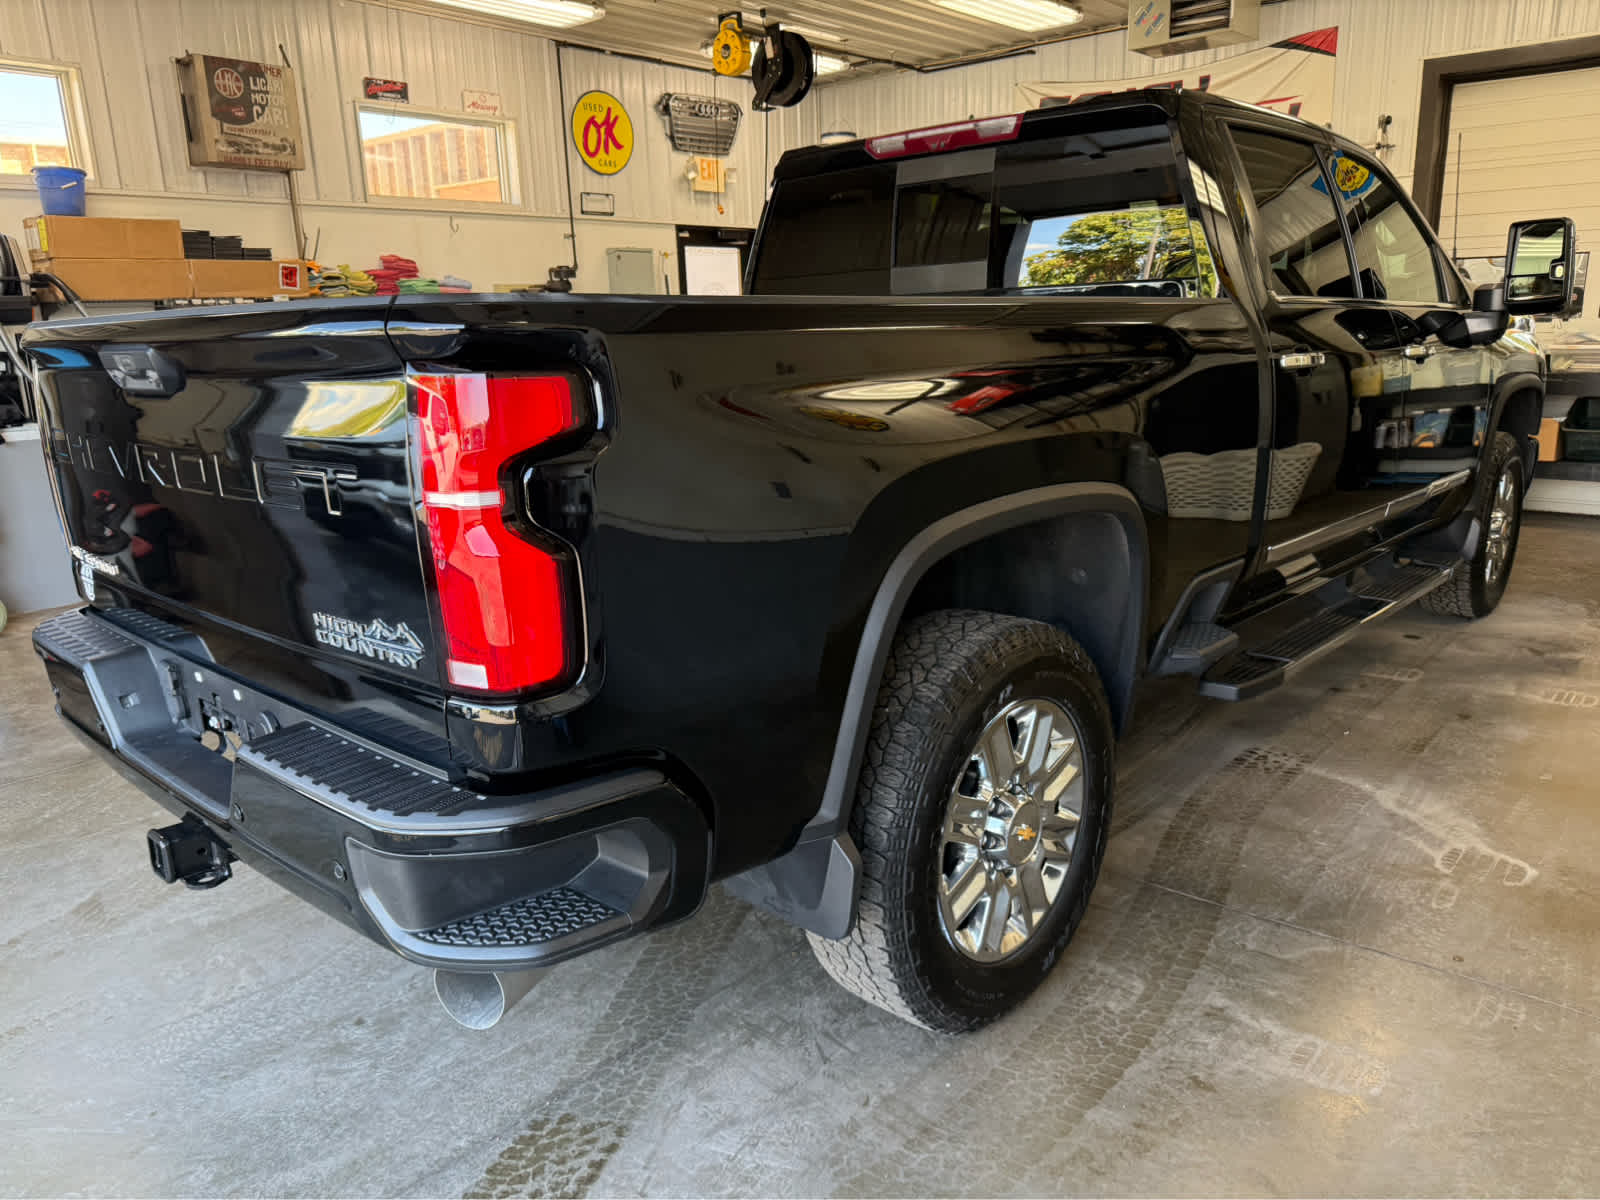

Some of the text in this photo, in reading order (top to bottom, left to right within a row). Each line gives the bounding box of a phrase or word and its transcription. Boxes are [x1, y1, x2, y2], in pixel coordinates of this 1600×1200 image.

[251, 92, 286, 106] MOTOR
[583, 102, 604, 112] USED
[583, 106, 624, 158] OK
[598, 159, 617, 168] CARS
[312, 611, 367, 638] HIGH
[315, 628, 425, 670] COUNTRY
